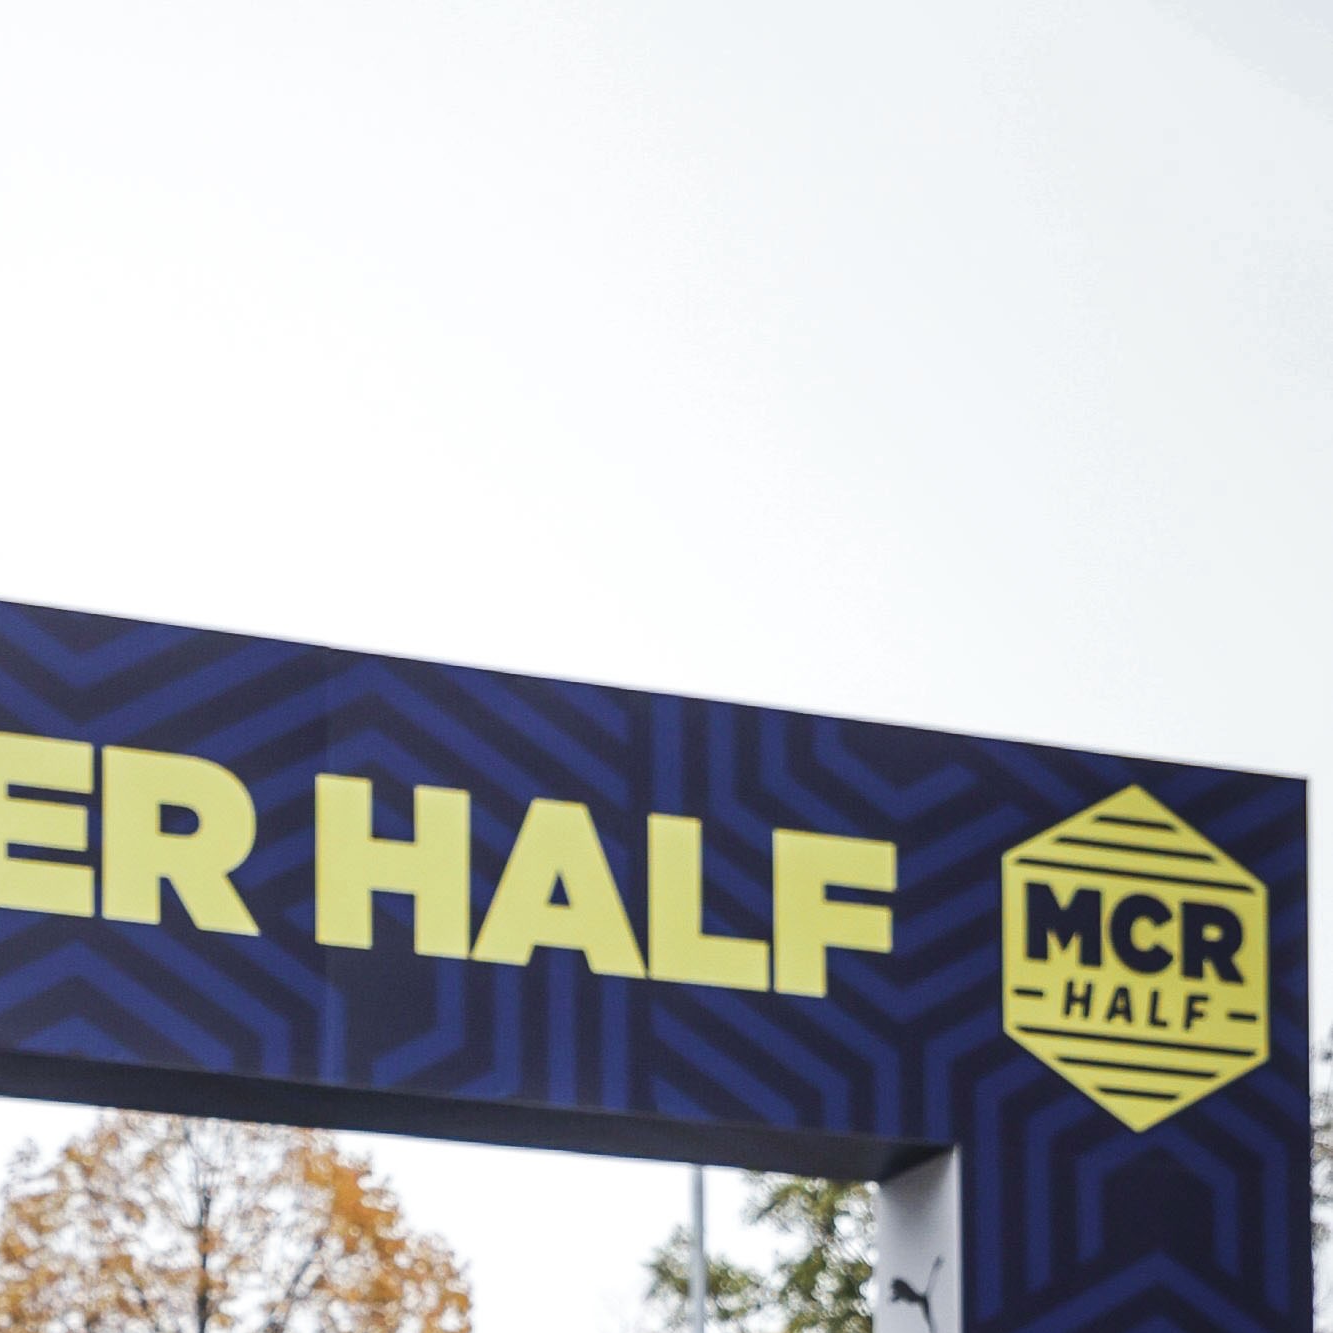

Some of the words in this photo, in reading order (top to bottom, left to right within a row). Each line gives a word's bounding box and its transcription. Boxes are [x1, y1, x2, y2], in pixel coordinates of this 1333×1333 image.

[315, 773, 898, 998] HALF
[1026, 880, 1245, 985] MCR
[1062, 980, 1210, 1031] HALF
